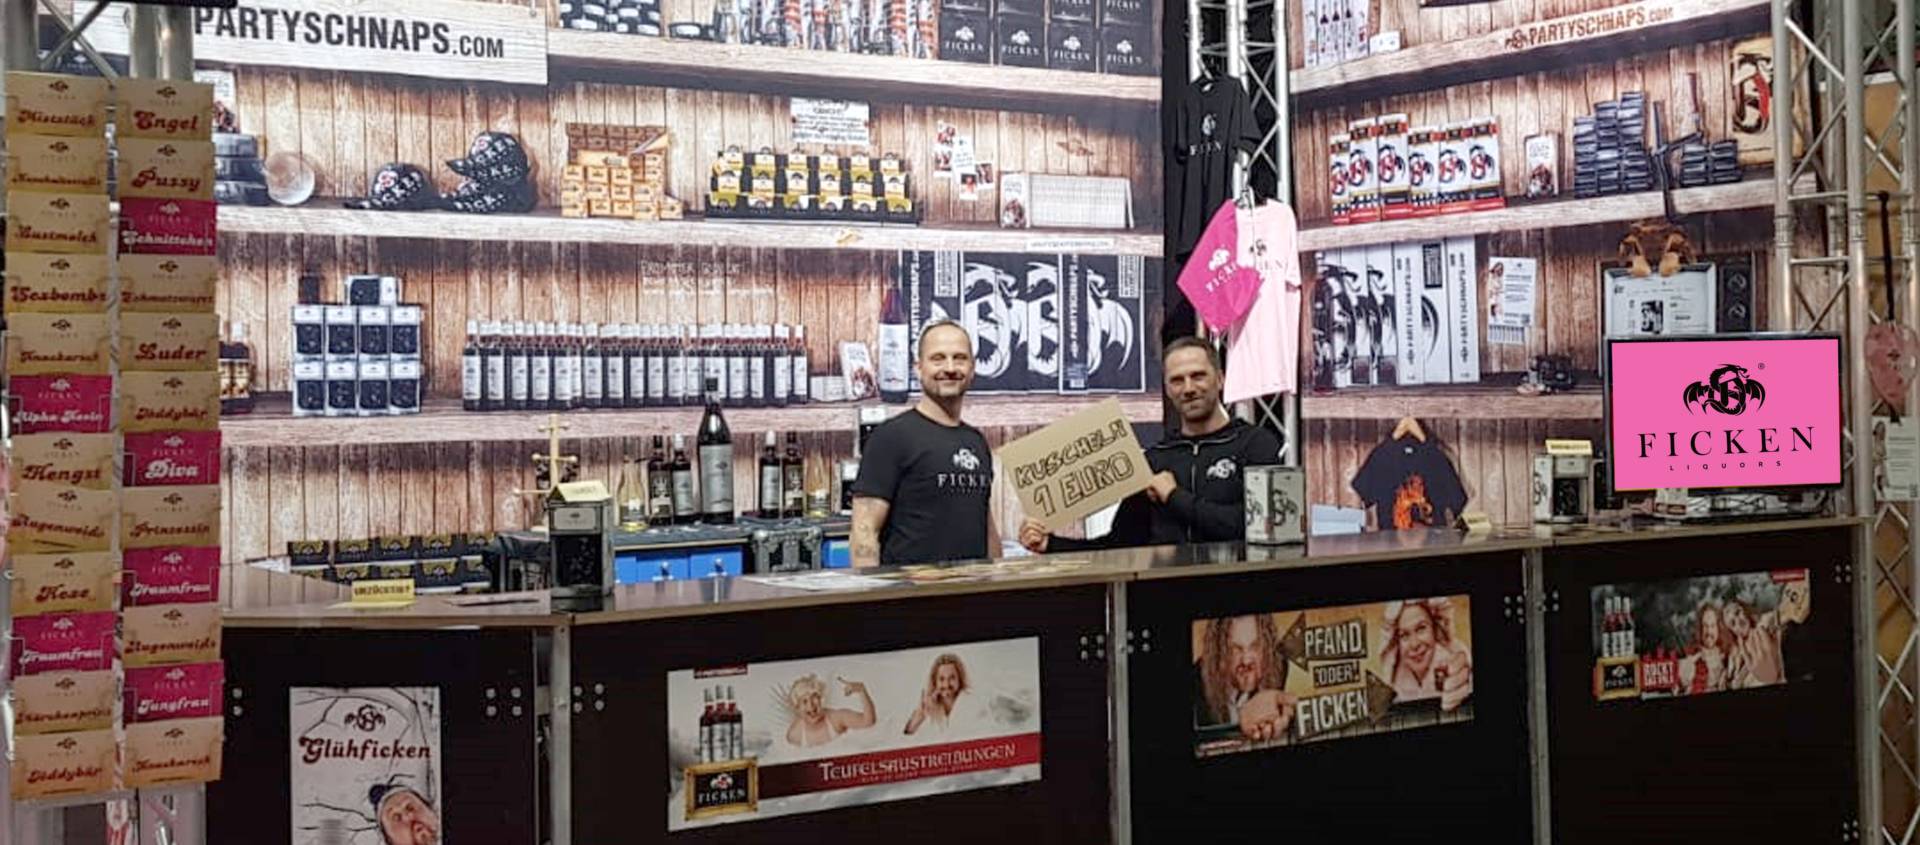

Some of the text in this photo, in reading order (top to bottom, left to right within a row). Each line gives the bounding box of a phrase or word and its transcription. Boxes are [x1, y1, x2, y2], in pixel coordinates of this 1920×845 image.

[1053, 49, 1091, 61] FICKEN
[133, 109, 199, 133] Engel
[131, 166, 201, 192] Pussy
[134, 342, 208, 361] Luder
[1637, 426, 1815, 458] FICKEN
[1015, 418, 1129, 489] KUSCHELN
[22, 462, 103, 484] Hengst
[144, 458, 199, 480] Diva
[1669, 460, 1783, 472] LIQUORS
[1033, 451, 1135, 517] 1 EURO
[35, 583, 91, 603] Hexe
[130, 582, 211, 597] Traumfrau
[137, 696, 210, 715] Jungfrau
[1297, 689, 1369, 736] FICKEN
[298, 736, 431, 764] Glühficken
[698, 789, 747, 803] FICKEN
